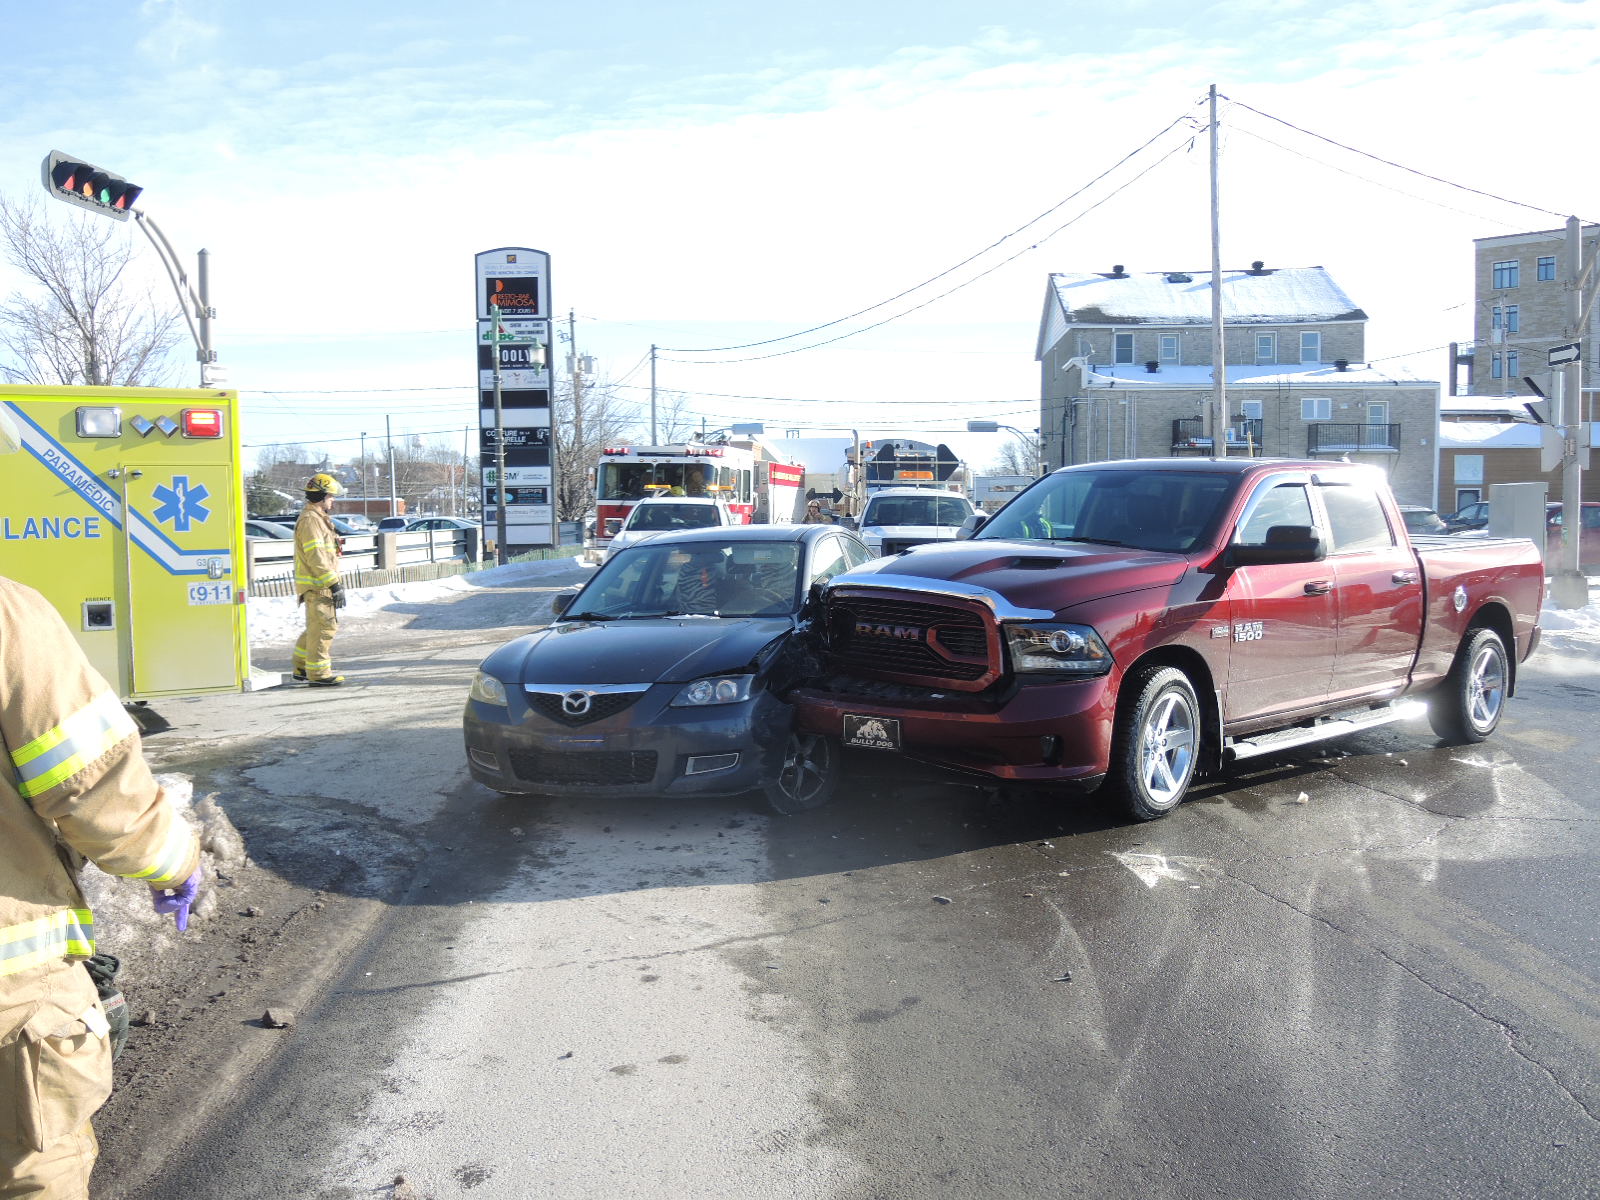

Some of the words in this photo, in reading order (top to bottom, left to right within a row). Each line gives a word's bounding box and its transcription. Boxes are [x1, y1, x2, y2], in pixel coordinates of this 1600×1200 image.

[43, 448, 114, 511] PARAMÉDIC
[197, 585, 231, 601] 9-1-1
[855, 621, 920, 640] RAM
[1234, 621, 1263, 633] RAM
[1233, 631, 1263, 643] 1500
[851, 737, 875, 746] BULLY
[876, 740, 893, 748] DOG
